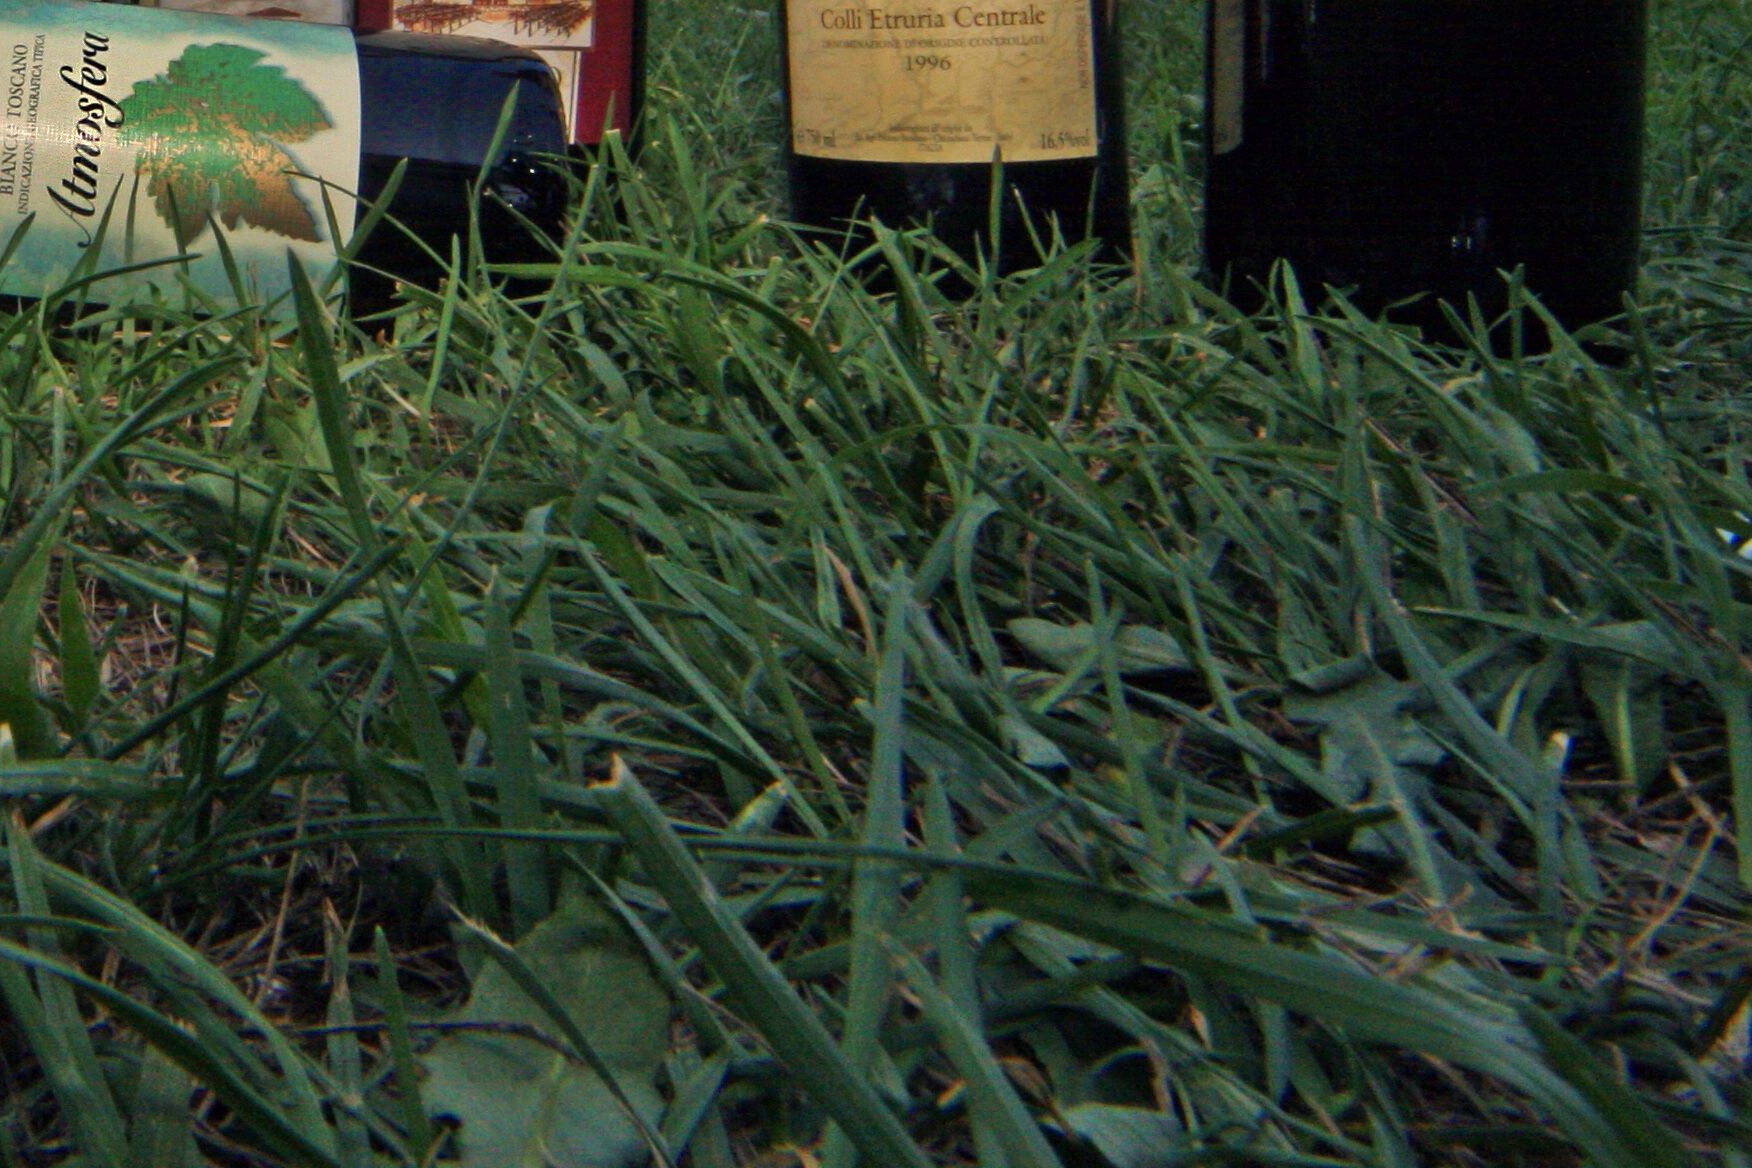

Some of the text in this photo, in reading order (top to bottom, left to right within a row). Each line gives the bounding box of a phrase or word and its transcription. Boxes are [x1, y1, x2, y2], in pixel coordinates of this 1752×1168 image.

[820, 4, 1047, 30] Colli Etruria Centrale
[6, 43, 29, 118] TOSCANO
[905, 55, 953, 72] 1996
[47, 31, 125, 248] Atmosfera
